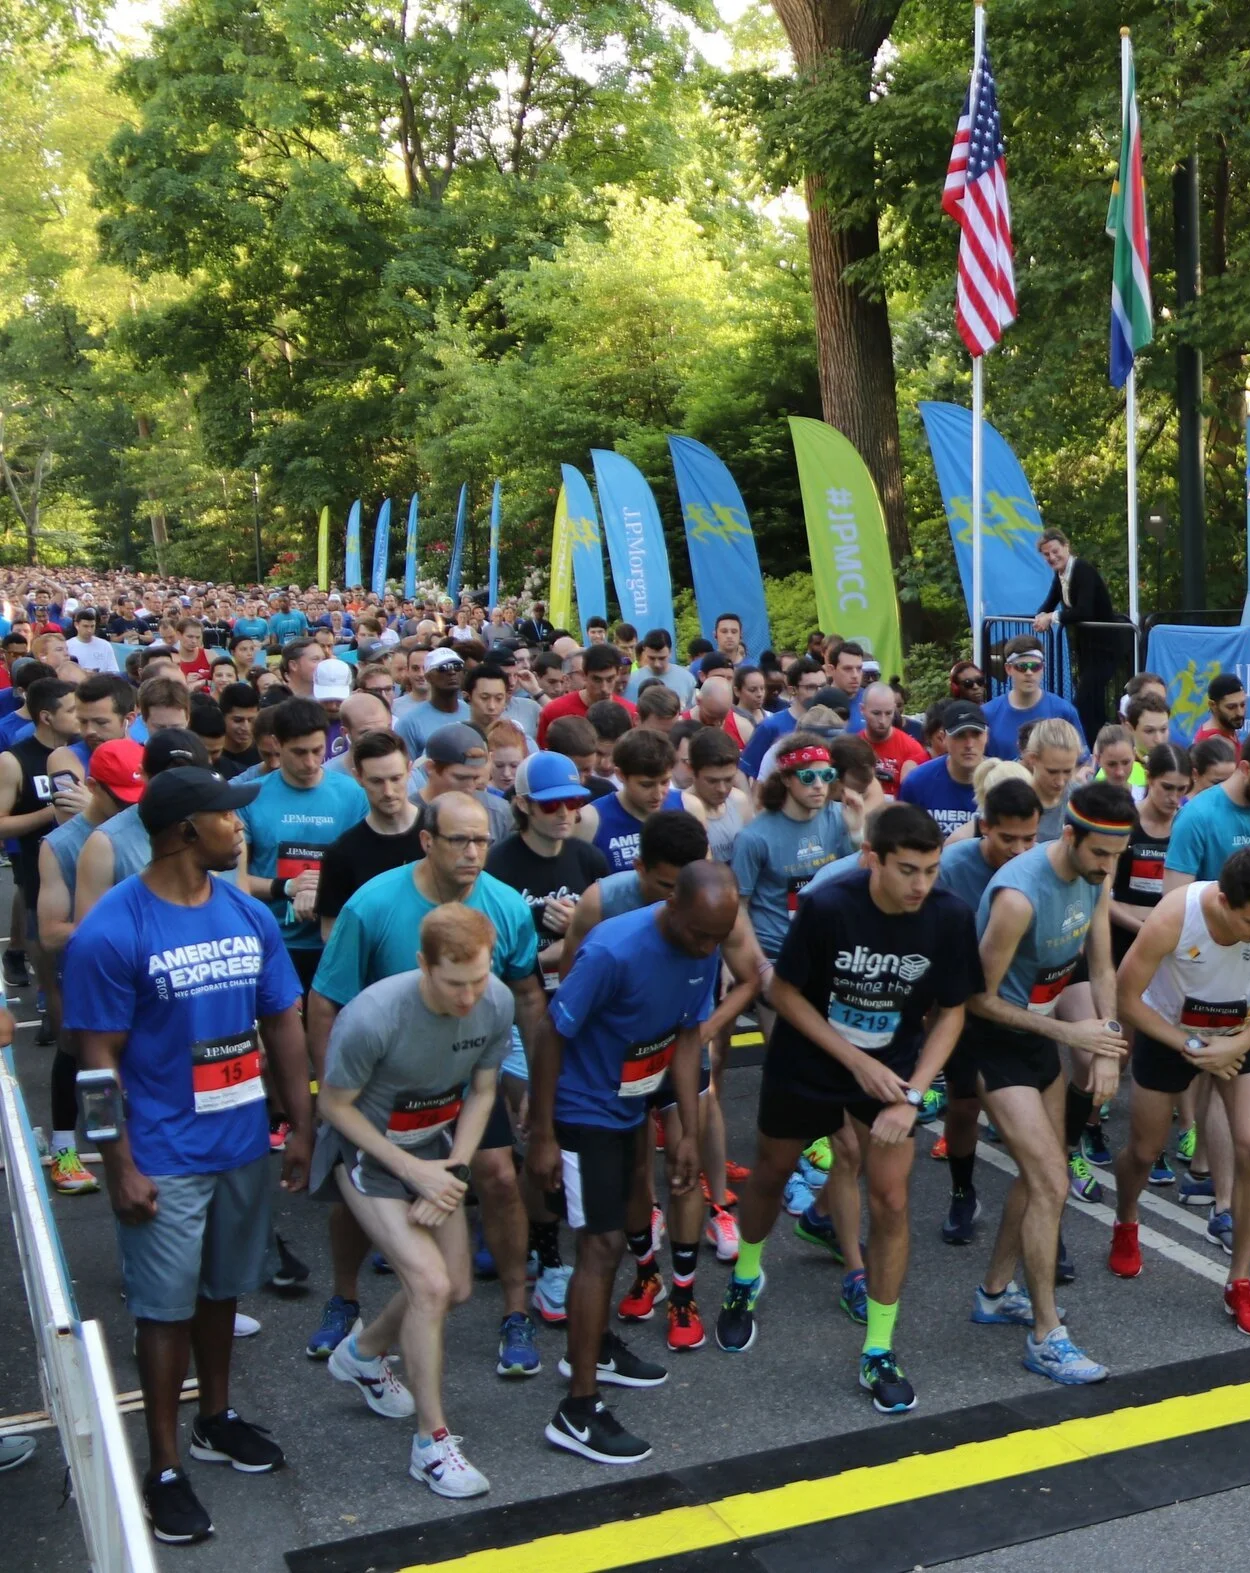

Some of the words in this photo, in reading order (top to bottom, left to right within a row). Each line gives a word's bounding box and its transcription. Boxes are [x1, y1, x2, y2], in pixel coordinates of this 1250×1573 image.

[623, 506, 649, 616] J.P.Morgan
[826, 486, 868, 611] #JPMCC
[281, 814, 334, 826] J.P.Morgan
[148, 936, 260, 976] AMERICAN
[834, 945, 900, 979] align
[169, 955, 260, 989] EXPRESS
[155, 976, 169, 1001] 2018
[843, 993, 895, 1009] J.P.Morgan
[843, 1009, 889, 1031] 1219
[204, 1040, 252, 1058] J.P.Morgan
[222, 1062, 243, 1083] 15
